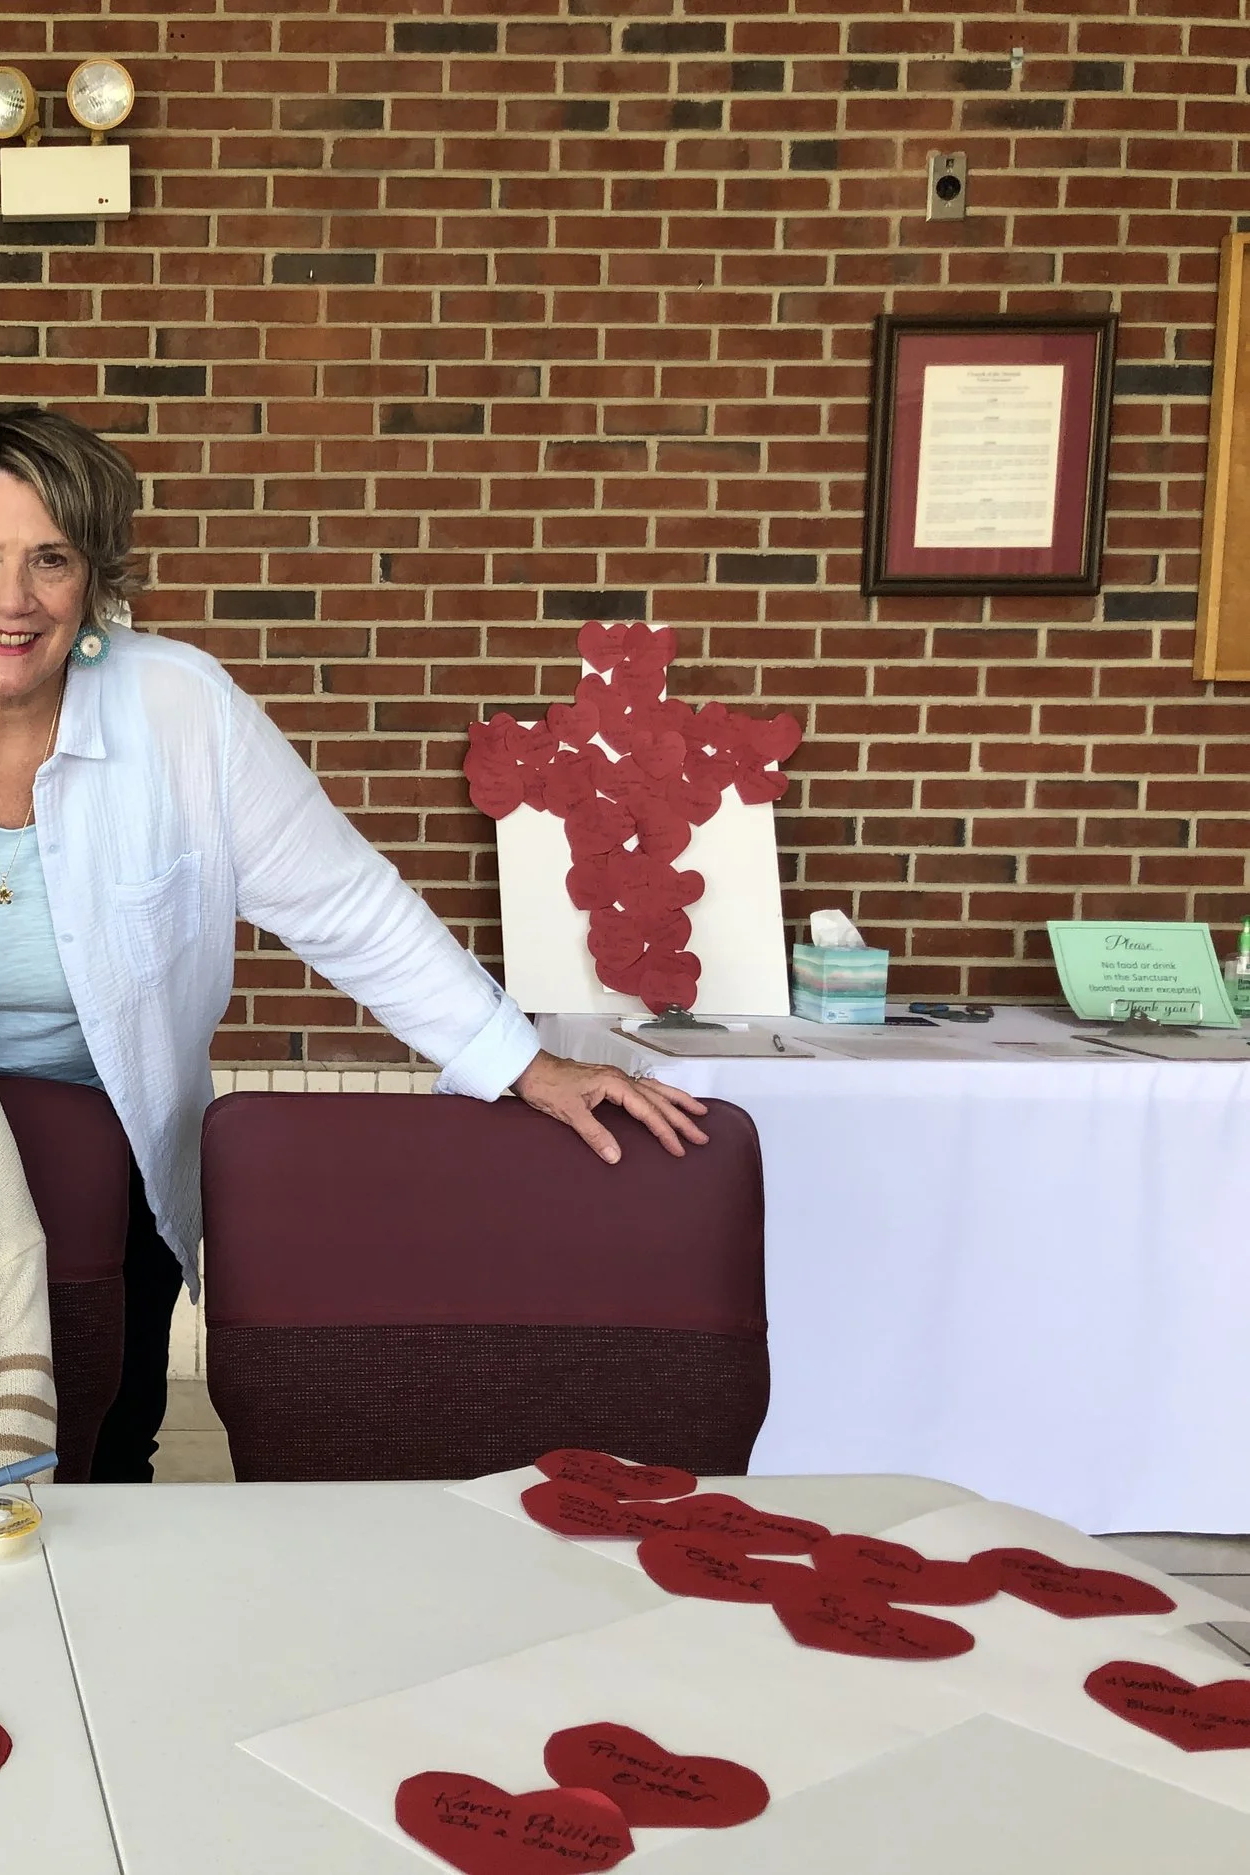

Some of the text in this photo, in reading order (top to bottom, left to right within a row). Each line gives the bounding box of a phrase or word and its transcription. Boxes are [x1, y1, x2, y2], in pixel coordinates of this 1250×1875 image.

[1101, 961, 1176, 970] No food or drink
[1103, 973, 1178, 983] in the Sanctuary
[1128, 985, 1154, 994] water
[1115, 998, 1195, 1016] Thank you!
[432, 1790, 622, 1850] Karen Phillips
